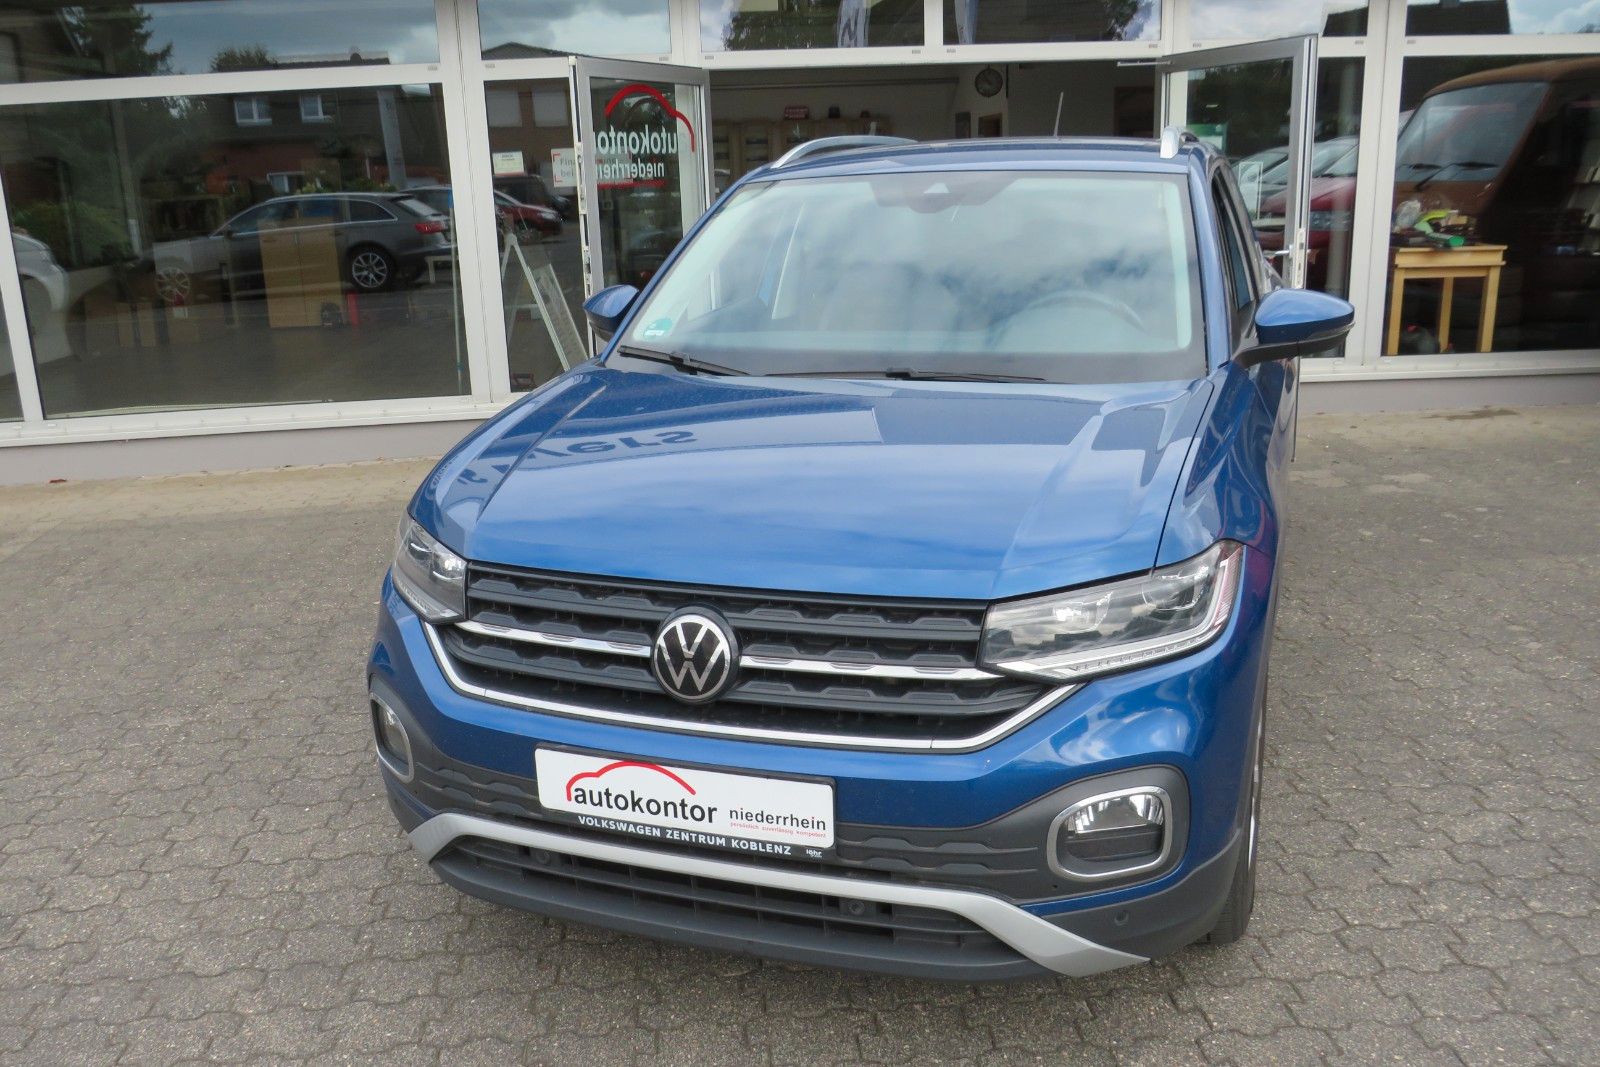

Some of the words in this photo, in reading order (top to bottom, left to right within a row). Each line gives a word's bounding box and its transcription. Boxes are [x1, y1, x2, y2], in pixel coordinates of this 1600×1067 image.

[574, 786, 718, 824] autokontor
[729, 807, 827, 831] niederrhein
[578, 814, 662, 839] VOLKSWAGEN
[666, 828, 727, 847] ZENTRUM
[731, 839, 792, 856] KOBLENZ
